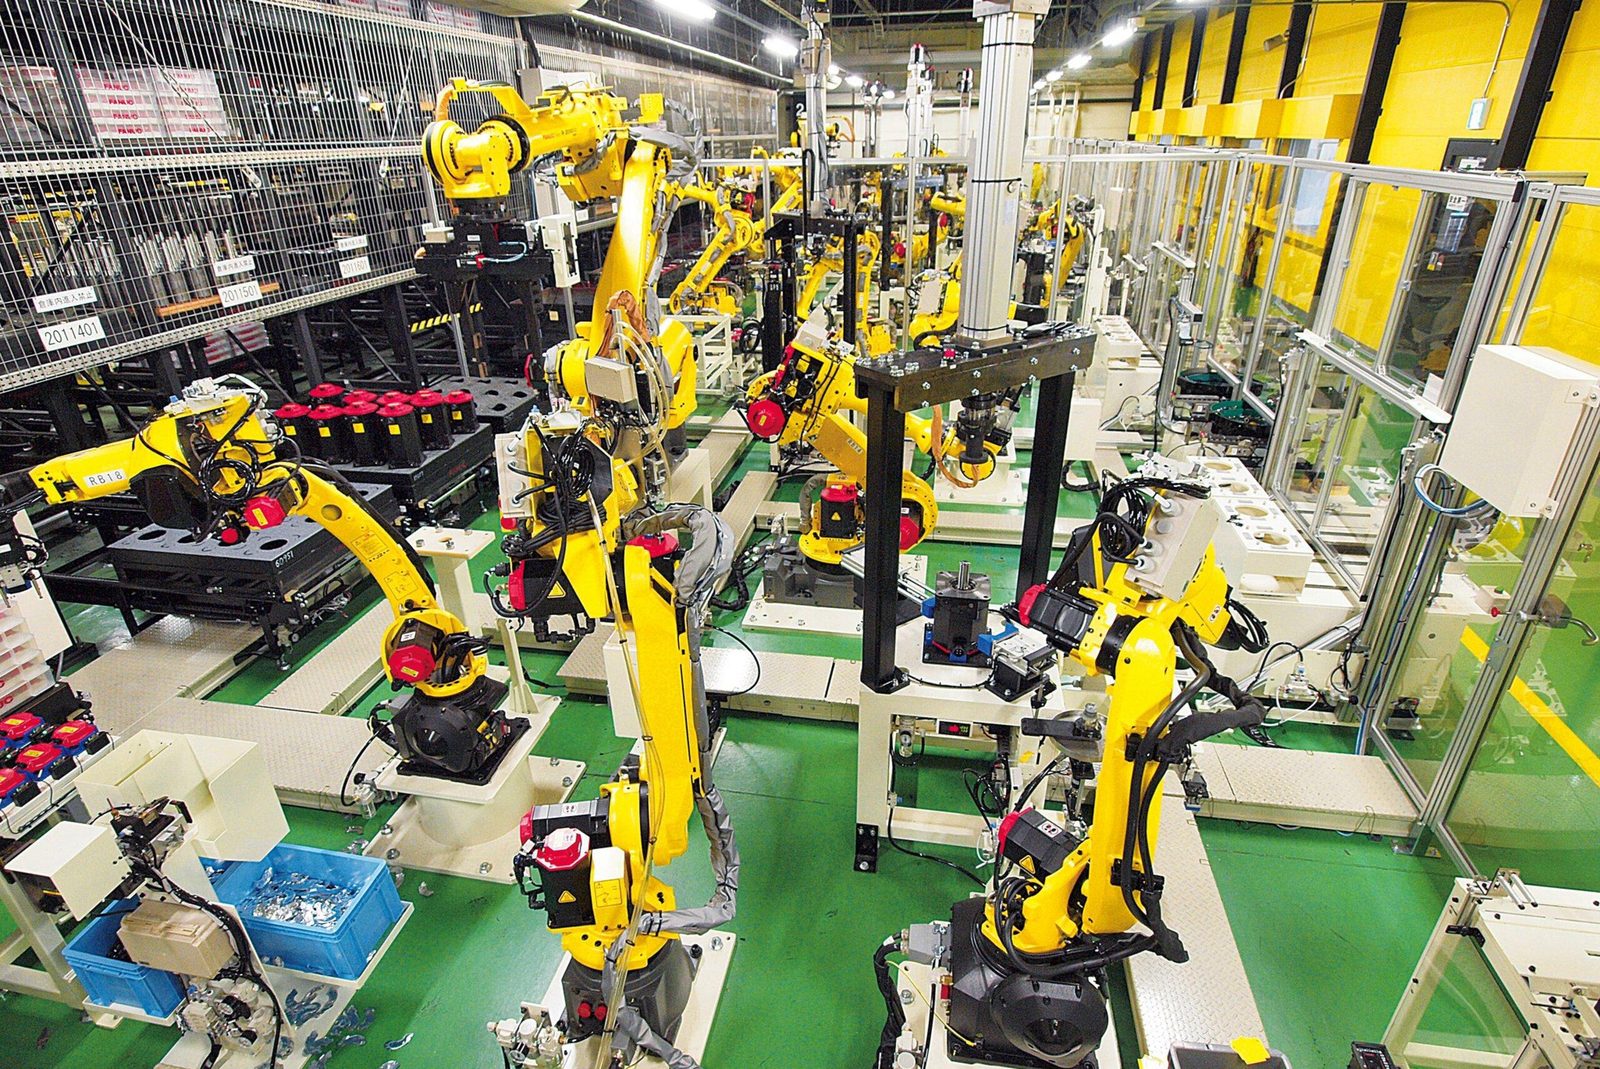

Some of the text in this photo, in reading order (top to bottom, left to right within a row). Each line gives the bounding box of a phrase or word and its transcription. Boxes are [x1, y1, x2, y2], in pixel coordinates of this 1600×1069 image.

[223, 285, 259, 303] 2011501
[45, 322, 99, 346] 2011401
[88, 471, 123, 486] RB18
